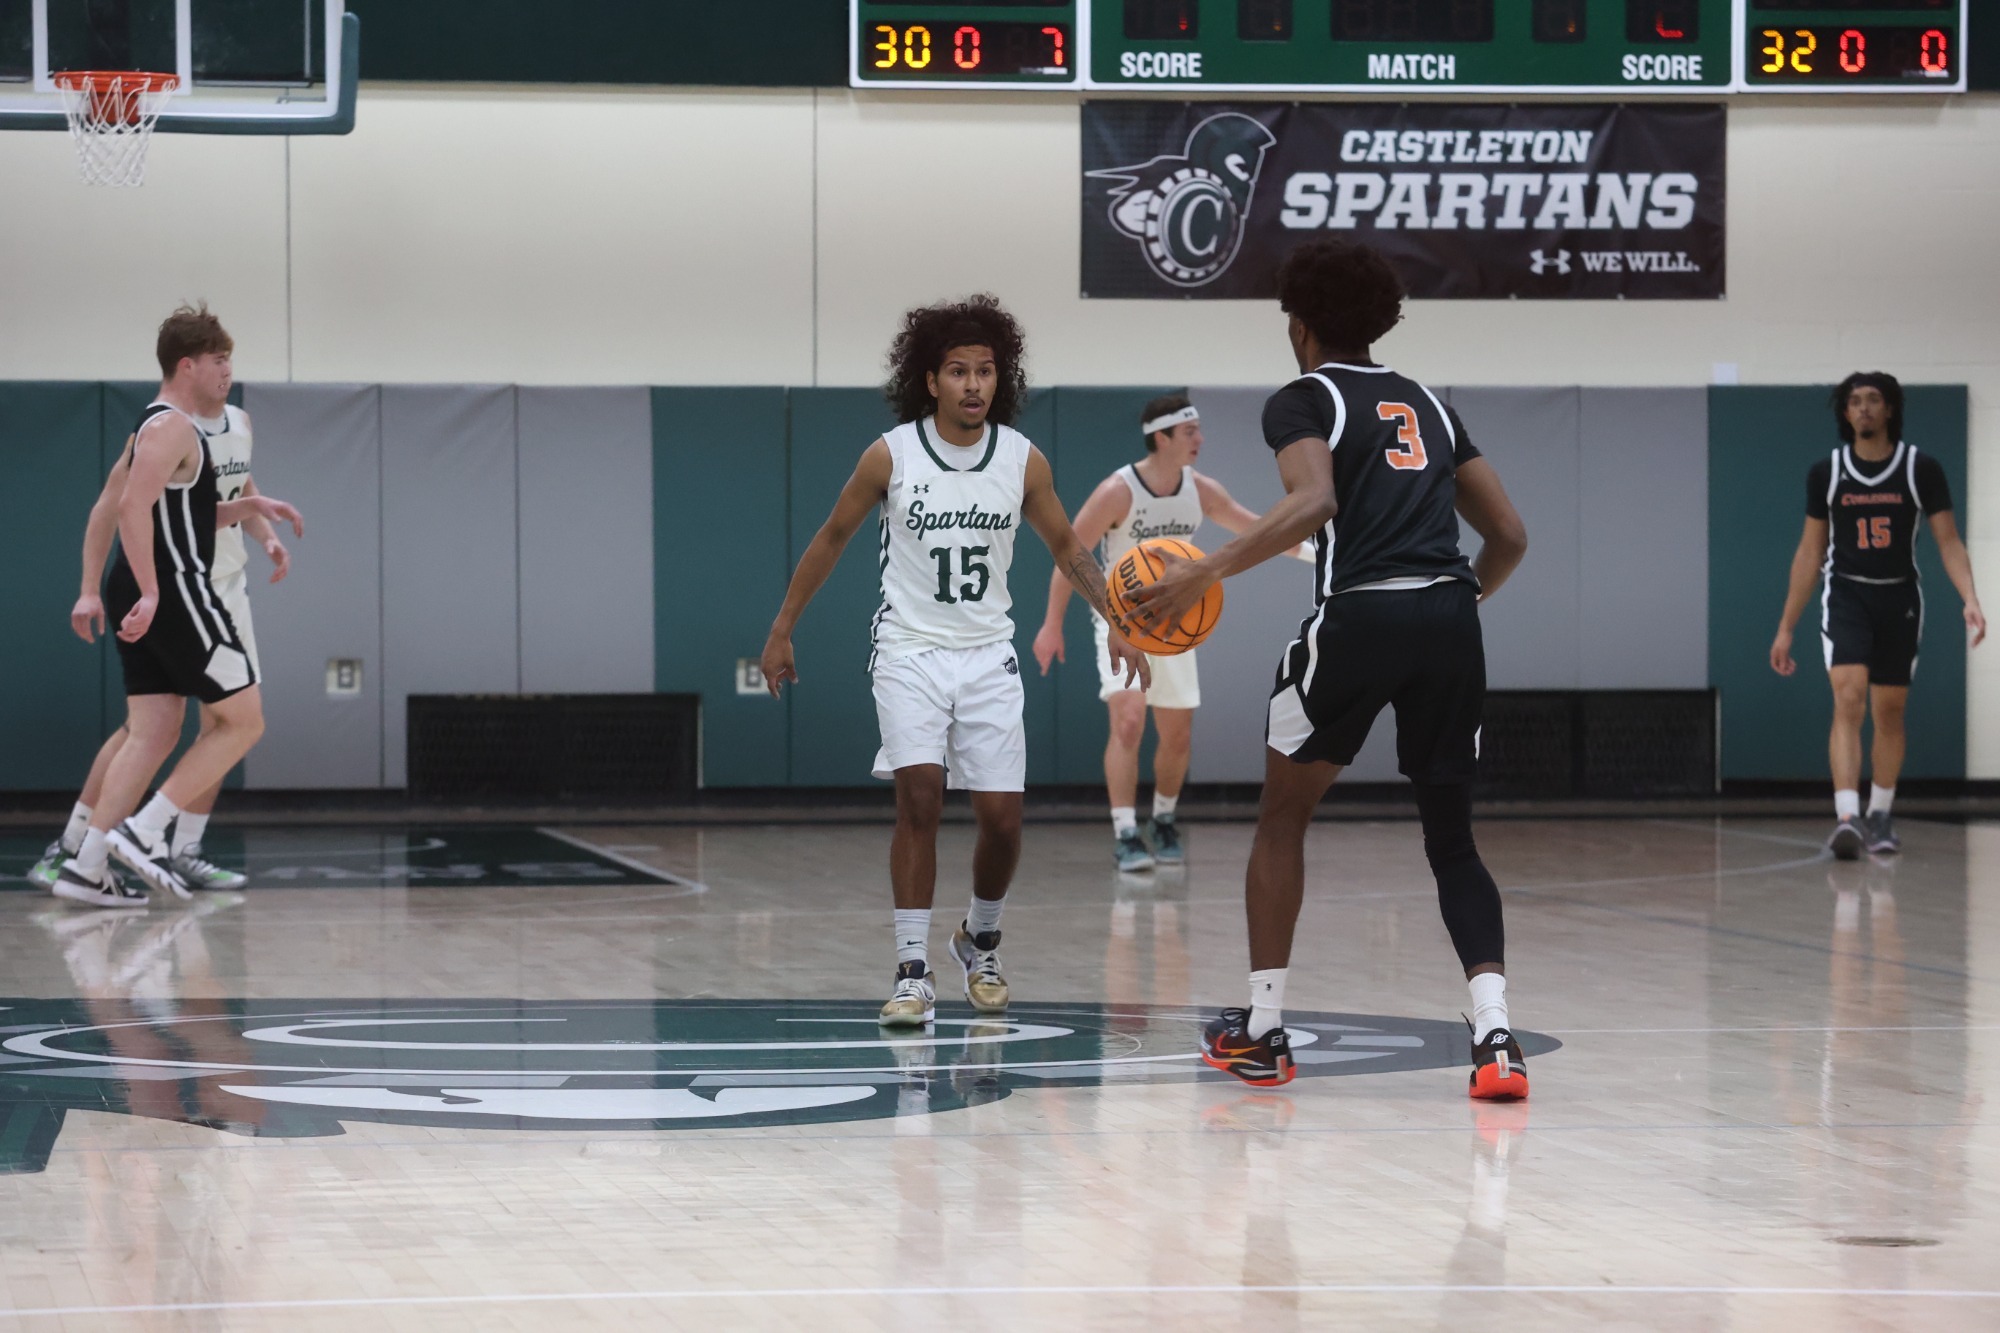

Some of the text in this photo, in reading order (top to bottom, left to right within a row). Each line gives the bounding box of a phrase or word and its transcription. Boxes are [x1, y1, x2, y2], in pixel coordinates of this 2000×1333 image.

[874, 25, 931, 69] 30
[954, 26, 981, 69] 0
[1041, 27, 1063, 66] 7
[1120, 51, 1202, 78] SCORE
[1367, 54, 1456, 80] MATCH
[1621, 54, 1703, 81] SCORE
[1761, 29, 1817, 73] 32
[1839, 29, 1866, 73] 0
[1920, 29, 1947, 72] 0
[1340, 130, 1593, 163] CASTLETON
[1280, 172, 1698, 230] SPARTANS
[1580, 251, 1700, 273] WE WILL.
[1376, 401, 1428, 470] 3
[906, 499, 1012, 541] Spartans
[1856, 516, 1891, 549] 15
[929, 545, 990, 604] 15
